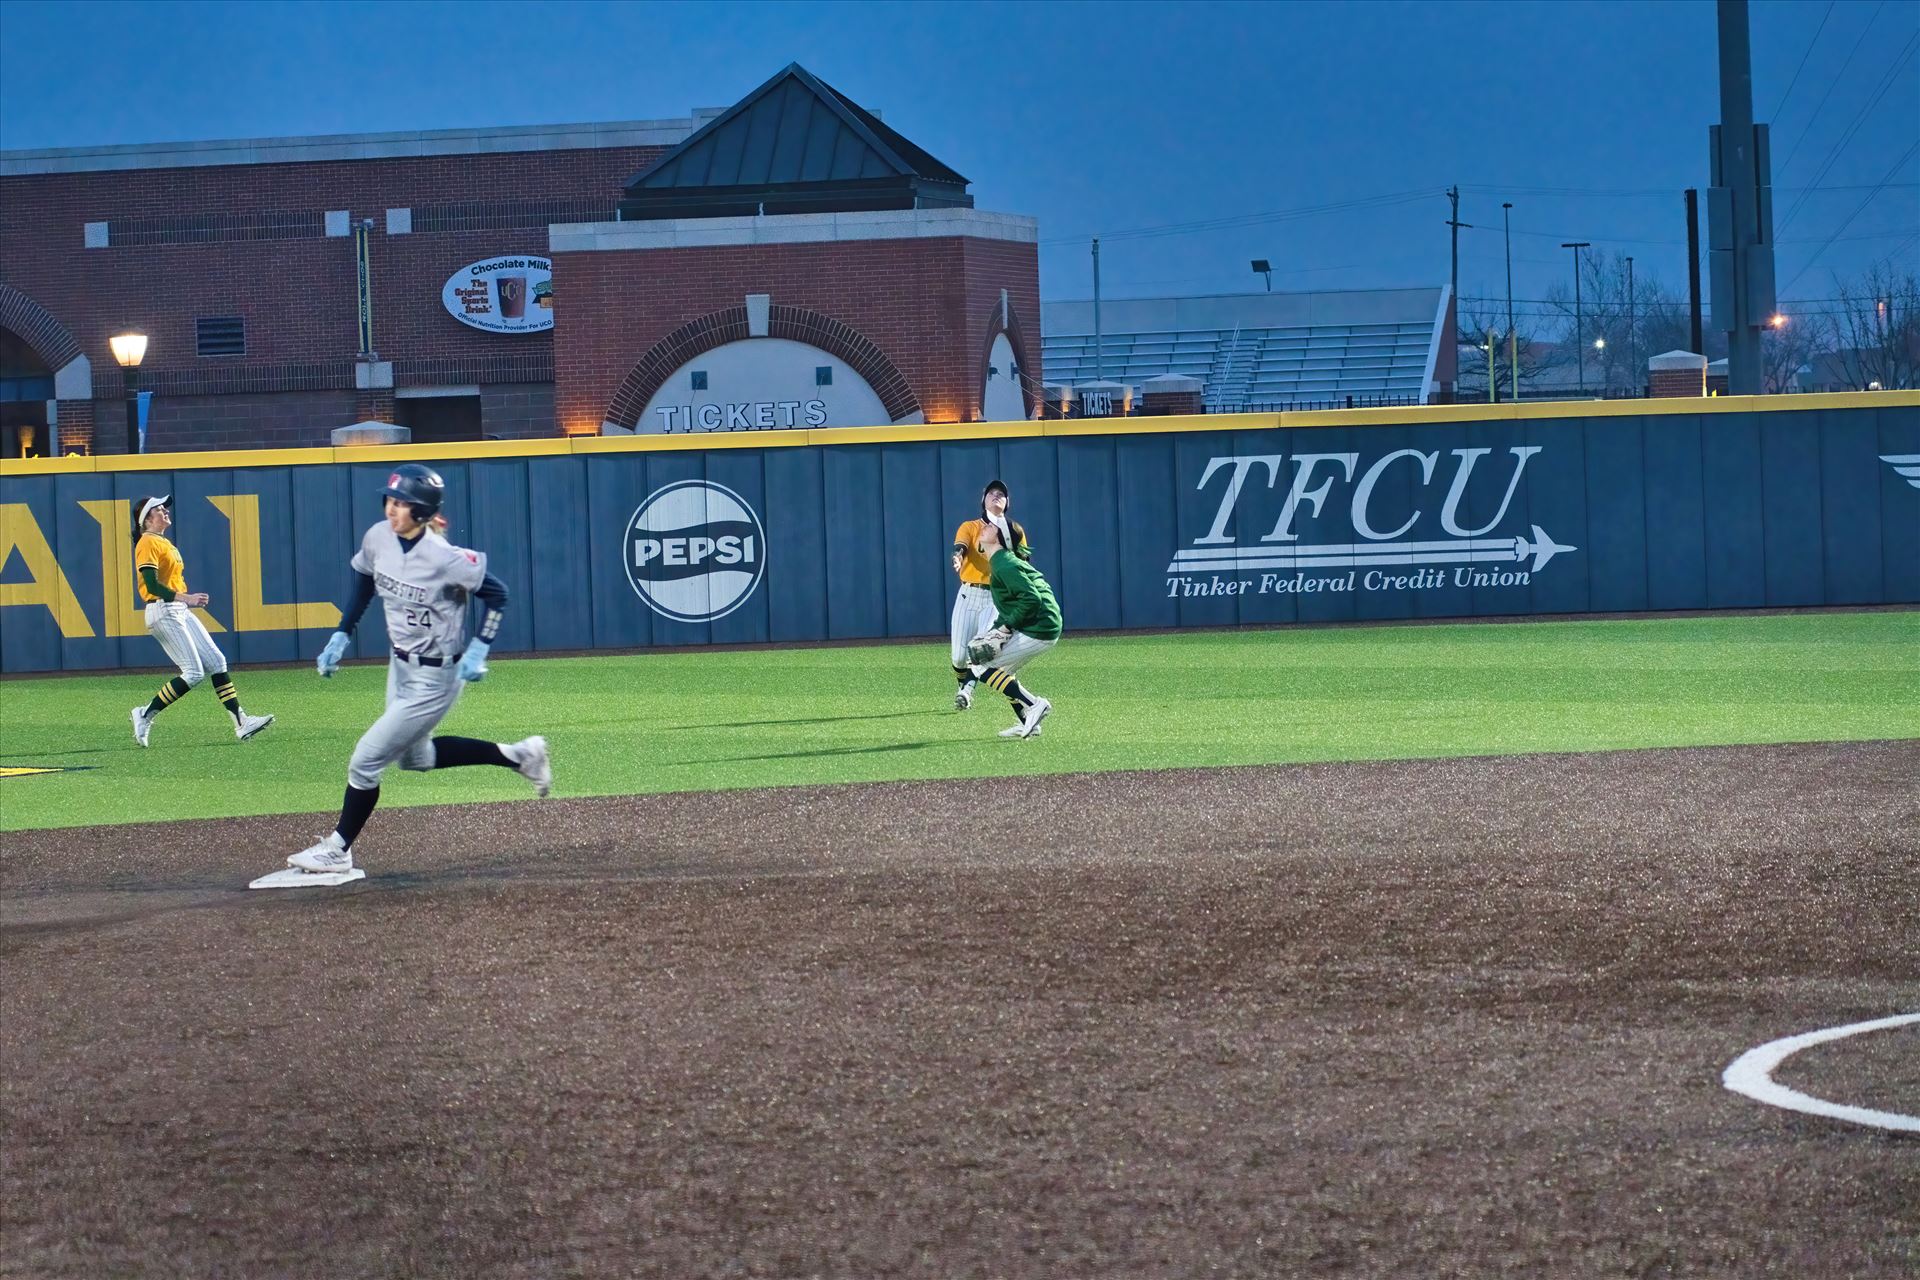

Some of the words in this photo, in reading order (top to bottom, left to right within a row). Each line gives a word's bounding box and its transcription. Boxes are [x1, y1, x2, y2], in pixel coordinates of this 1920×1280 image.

[470, 260, 525, 275] Chocolate
[454, 288, 488, 297] Original
[471, 279, 488, 288] The
[461, 297, 489, 306] Sports
[457, 312, 477, 324] Official
[478, 320, 503, 330] Nutrition
[539, 320, 552, 328] UCO
[1082, 392, 1112, 415] TICKETS
[656, 400, 827, 432] TICKETS
[1193, 446, 1543, 544] TFCU
[635, 535, 754, 567] PEPSI
[1166, 575, 1253, 597] Tinker
[1258, 571, 1356, 594] Federal
[1364, 568, 1446, 591] Credit
[1454, 566, 1531, 588] Union
[405, 608, 432, 629] 24
